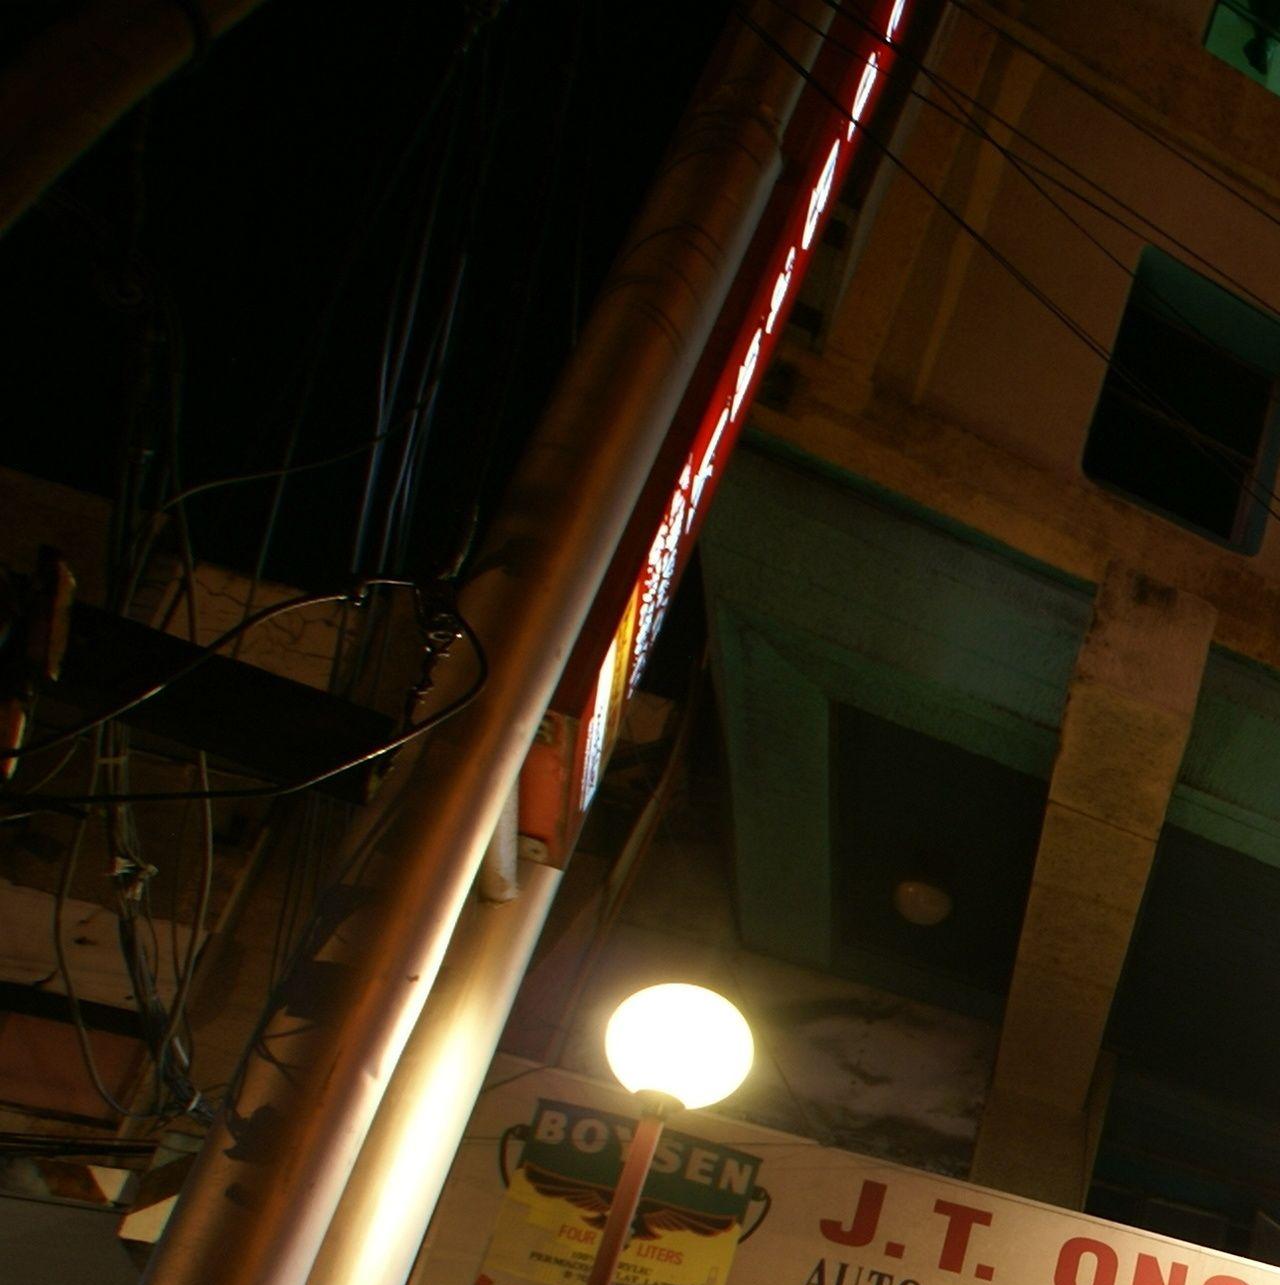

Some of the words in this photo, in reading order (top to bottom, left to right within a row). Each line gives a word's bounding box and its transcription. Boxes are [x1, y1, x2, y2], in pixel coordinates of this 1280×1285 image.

[558, 1224, 597, 1245] FOUR
[635, 1243, 684, 1265] LITERS
[819, 1179, 996, 1281] J.T.
